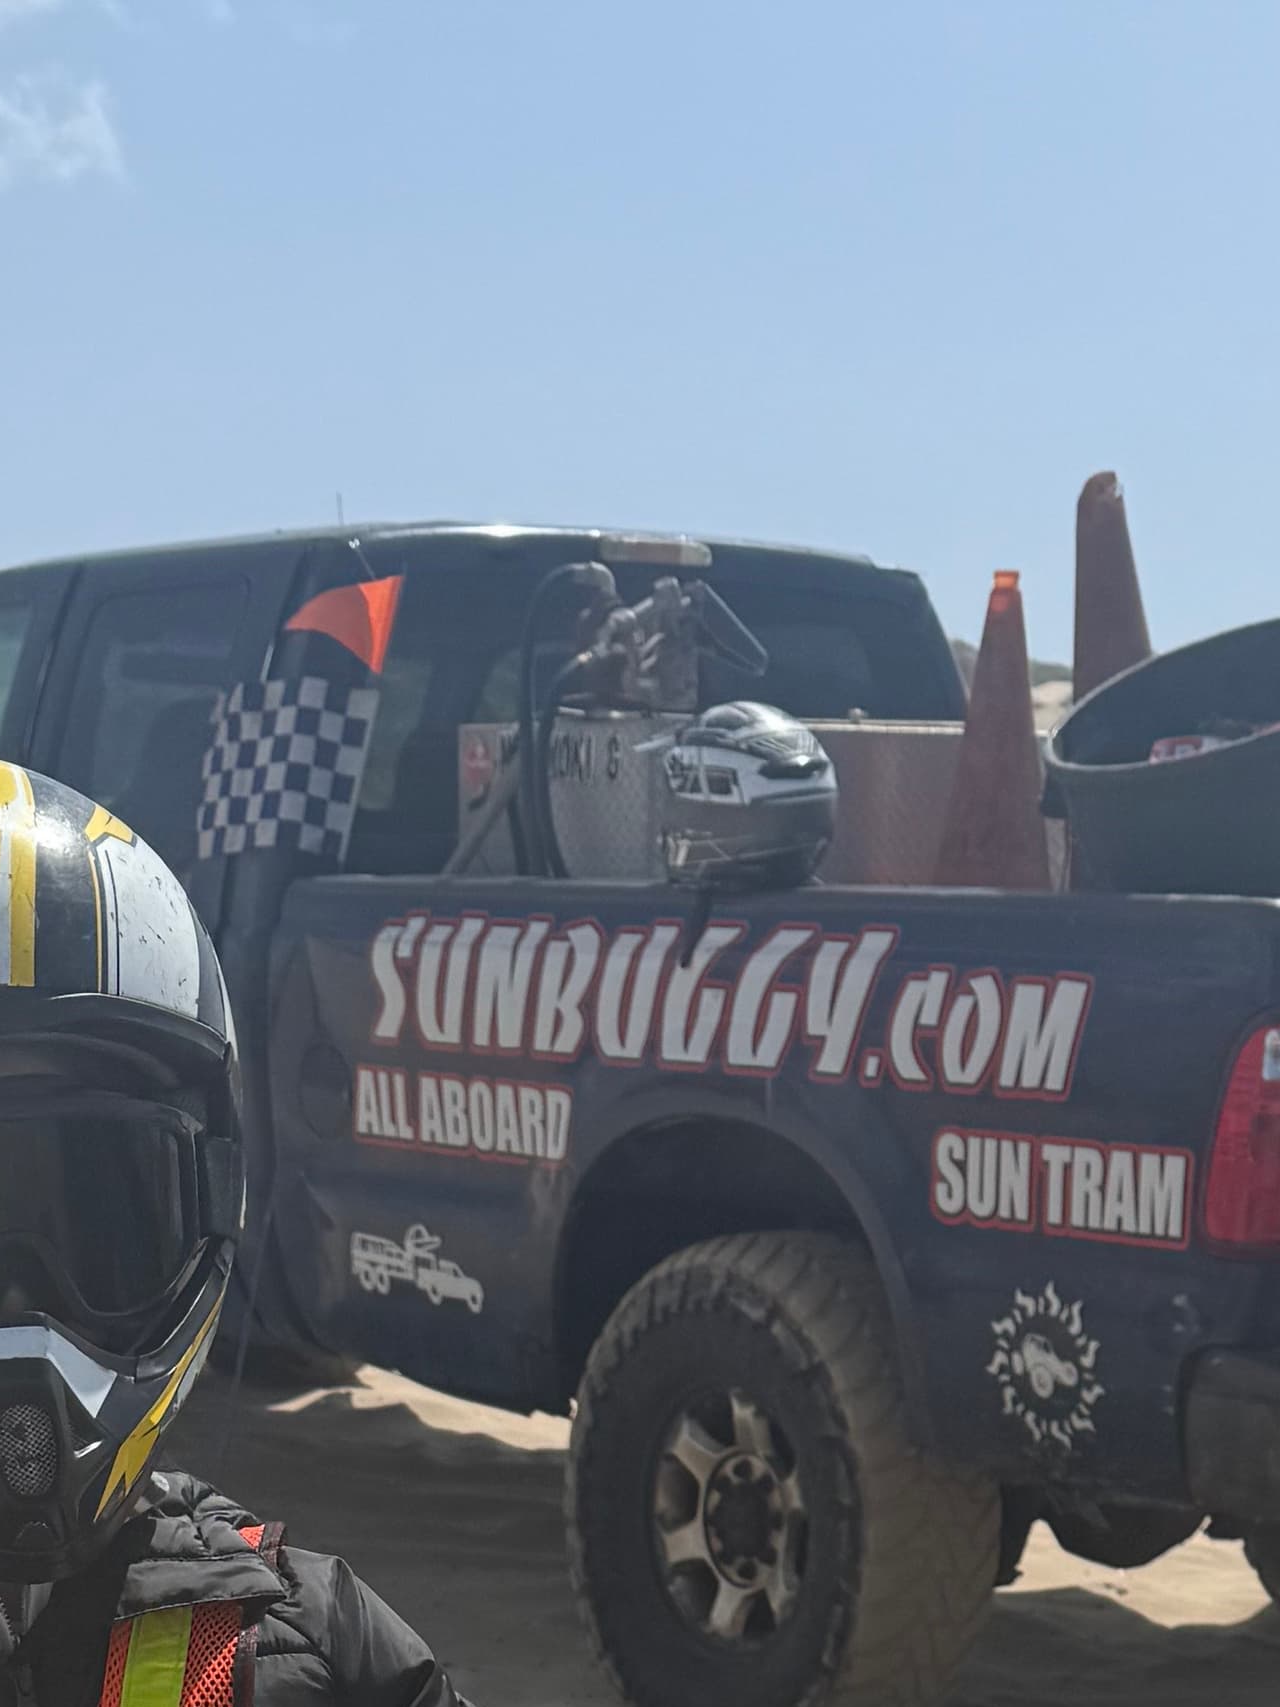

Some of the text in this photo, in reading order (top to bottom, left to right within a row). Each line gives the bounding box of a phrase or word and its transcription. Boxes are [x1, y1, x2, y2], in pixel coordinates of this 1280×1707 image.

[368, 912, 1092, 1099] SUNBUGGY.COM
[354, 1066, 574, 1162] ALL ABOARD
[933, 1130, 1188, 1240] SUN TRAM
